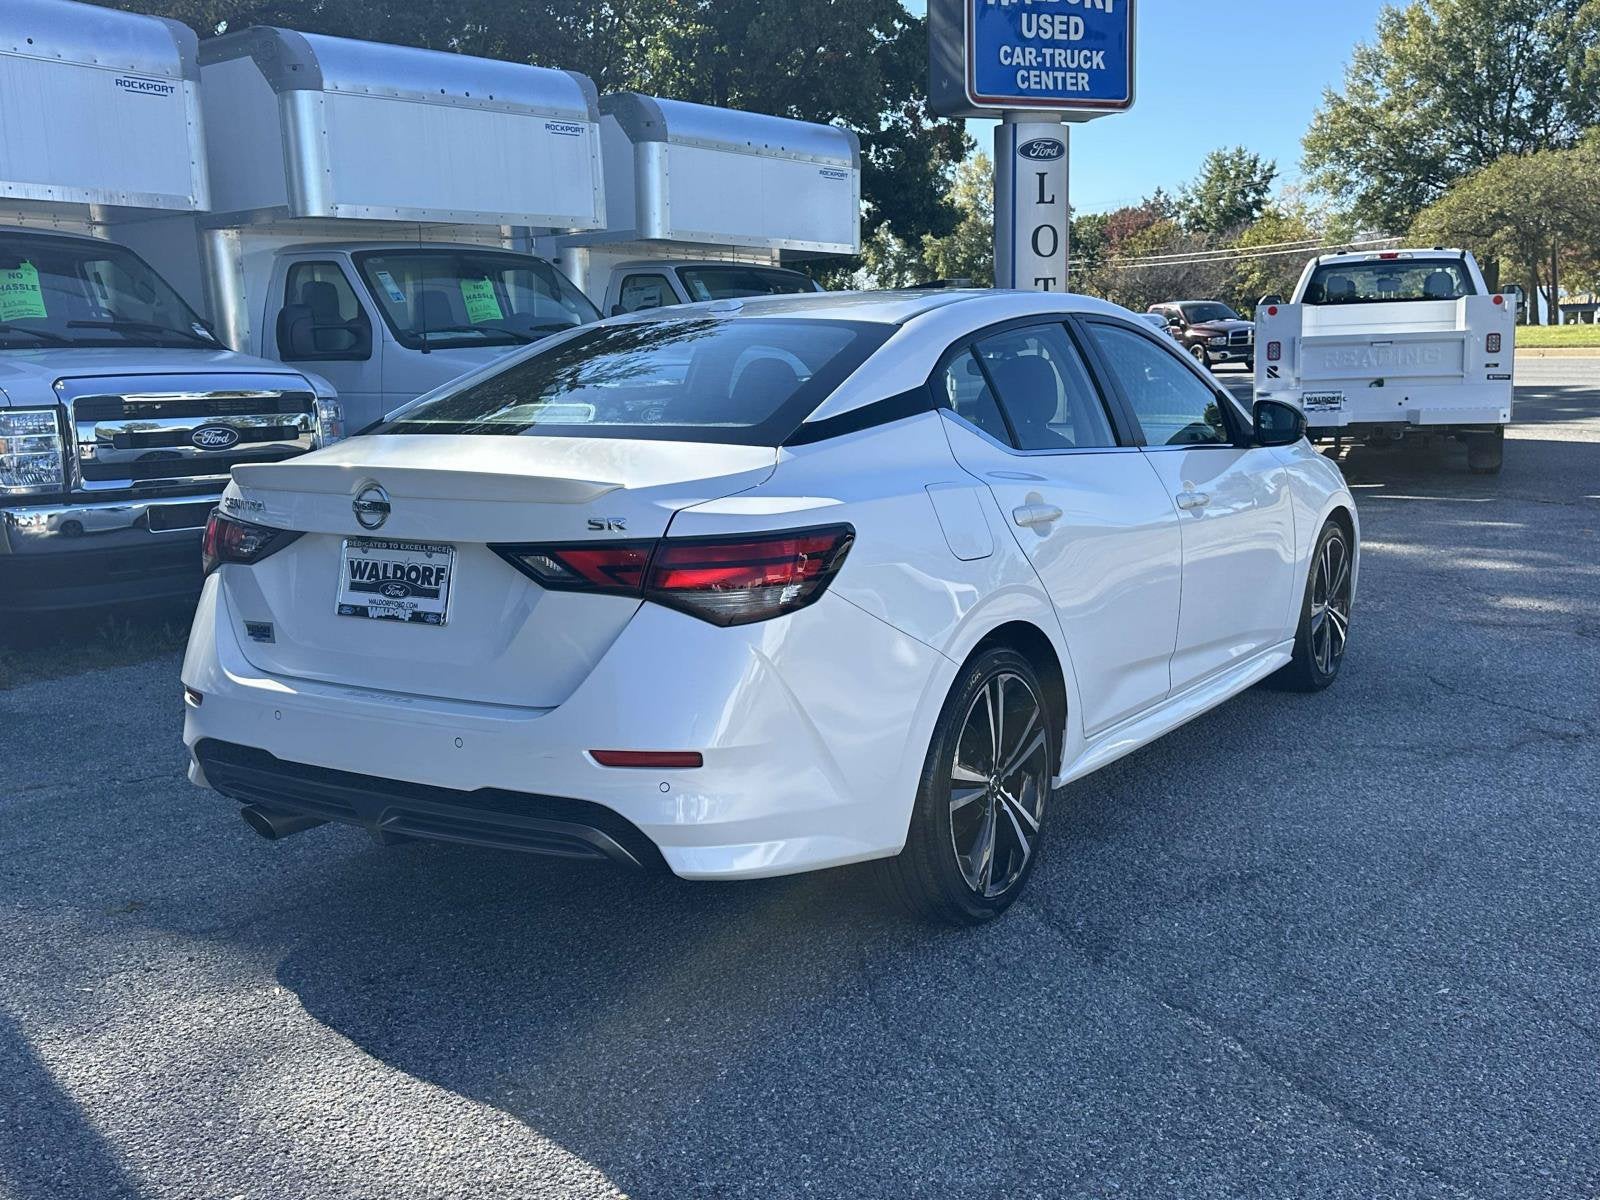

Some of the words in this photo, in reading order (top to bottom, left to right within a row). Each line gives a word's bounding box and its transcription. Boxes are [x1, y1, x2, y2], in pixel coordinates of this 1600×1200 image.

[1021, 13, 1085, 41] USED
[1000, 45, 1105, 70] CAR-TRUCK
[115, 79, 175, 93] ROCKPORT
[1016, 69, 1090, 92] CENTER
[545, 123, 585, 134] ROCKPORT
[1029, 141, 1059, 157] Ford
[201, 430, 230, 444] Ford
[587, 518, 627, 531] SR
[349, 540, 387, 549] DEDICATED
[349, 560, 446, 587] WALDORF
[385, 583, 405, 597] Ford
[367, 606, 413, 621] WALDORF
